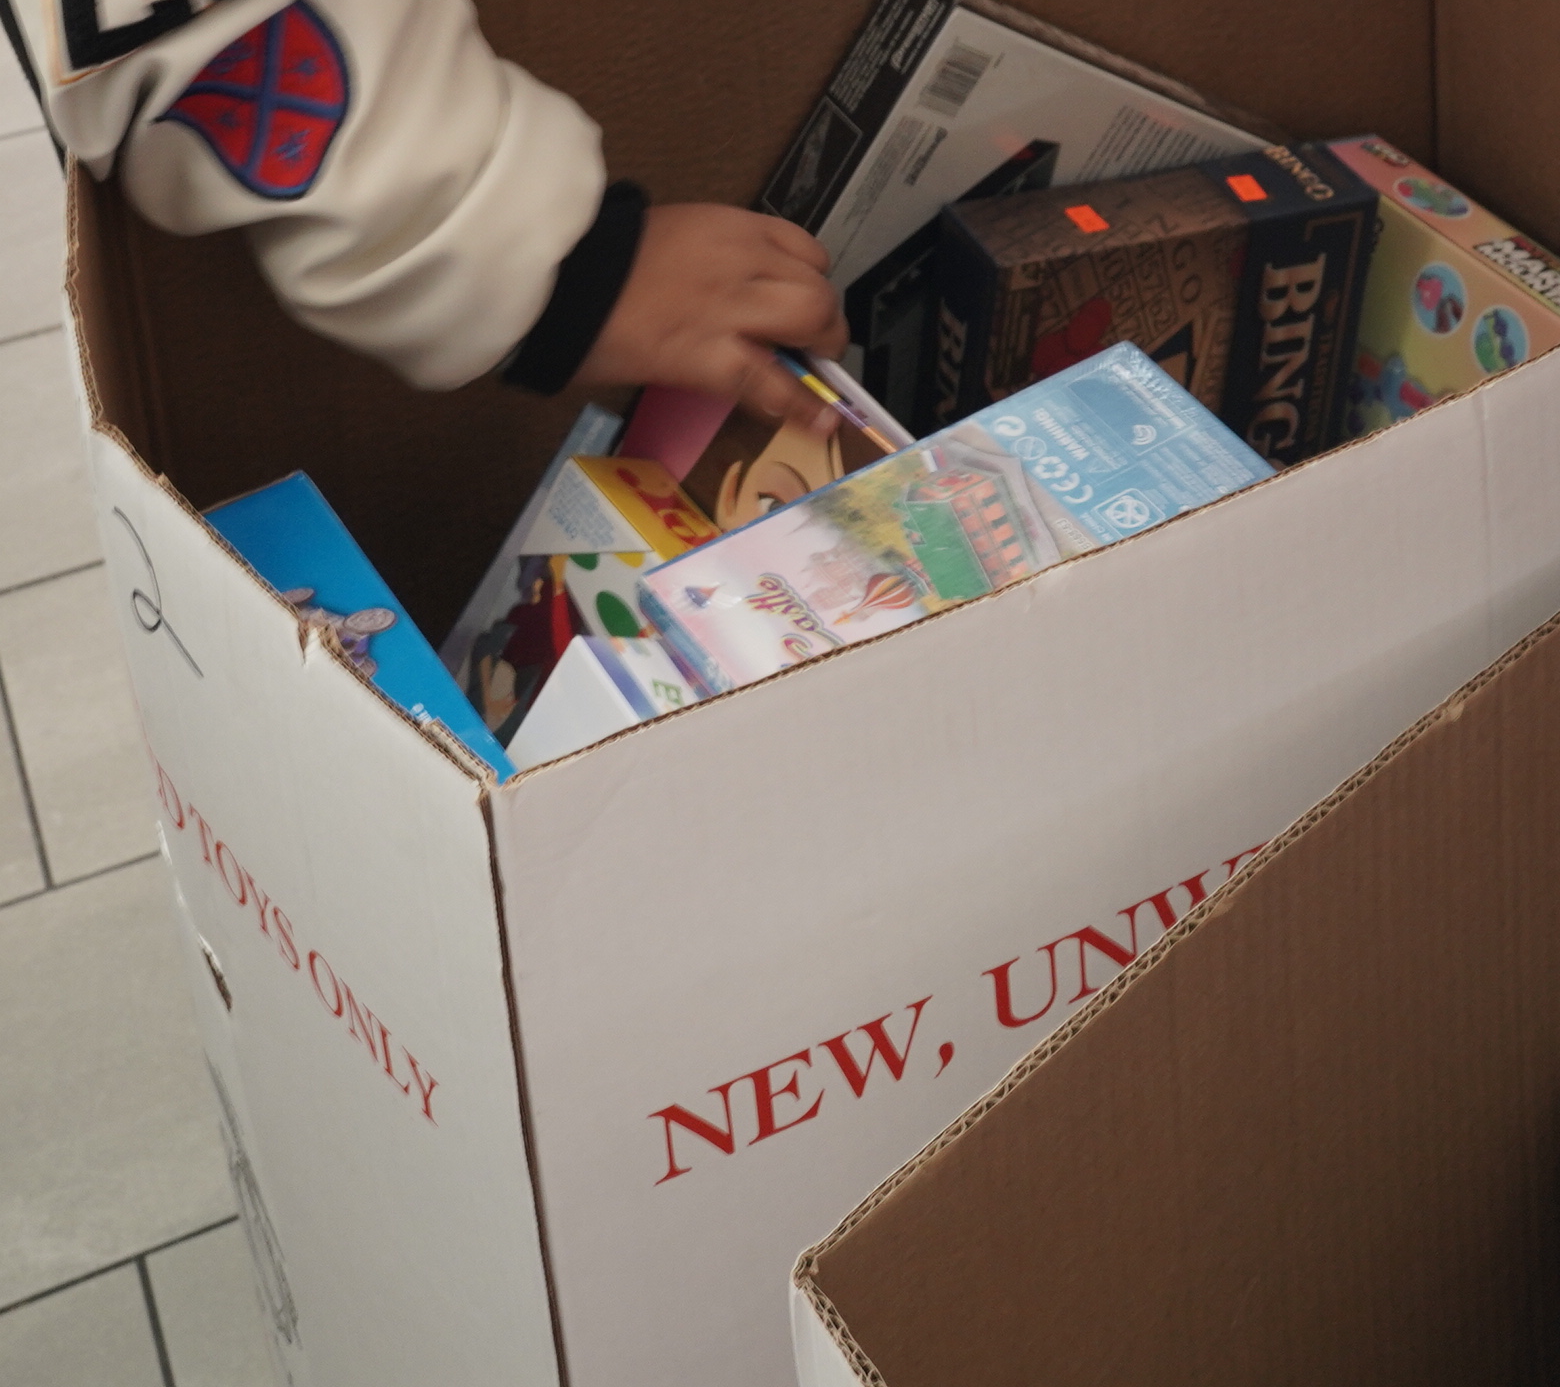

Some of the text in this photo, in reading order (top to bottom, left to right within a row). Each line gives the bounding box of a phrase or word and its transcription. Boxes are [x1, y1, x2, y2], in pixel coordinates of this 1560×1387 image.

[1263, 144, 1335, 202] BINGO
[1246, 251, 1328, 467] BING
[188, 801, 301, 971] TOYS
[307, 949, 440, 1128] ONLY
[646, 993, 956, 1188] NEW,
